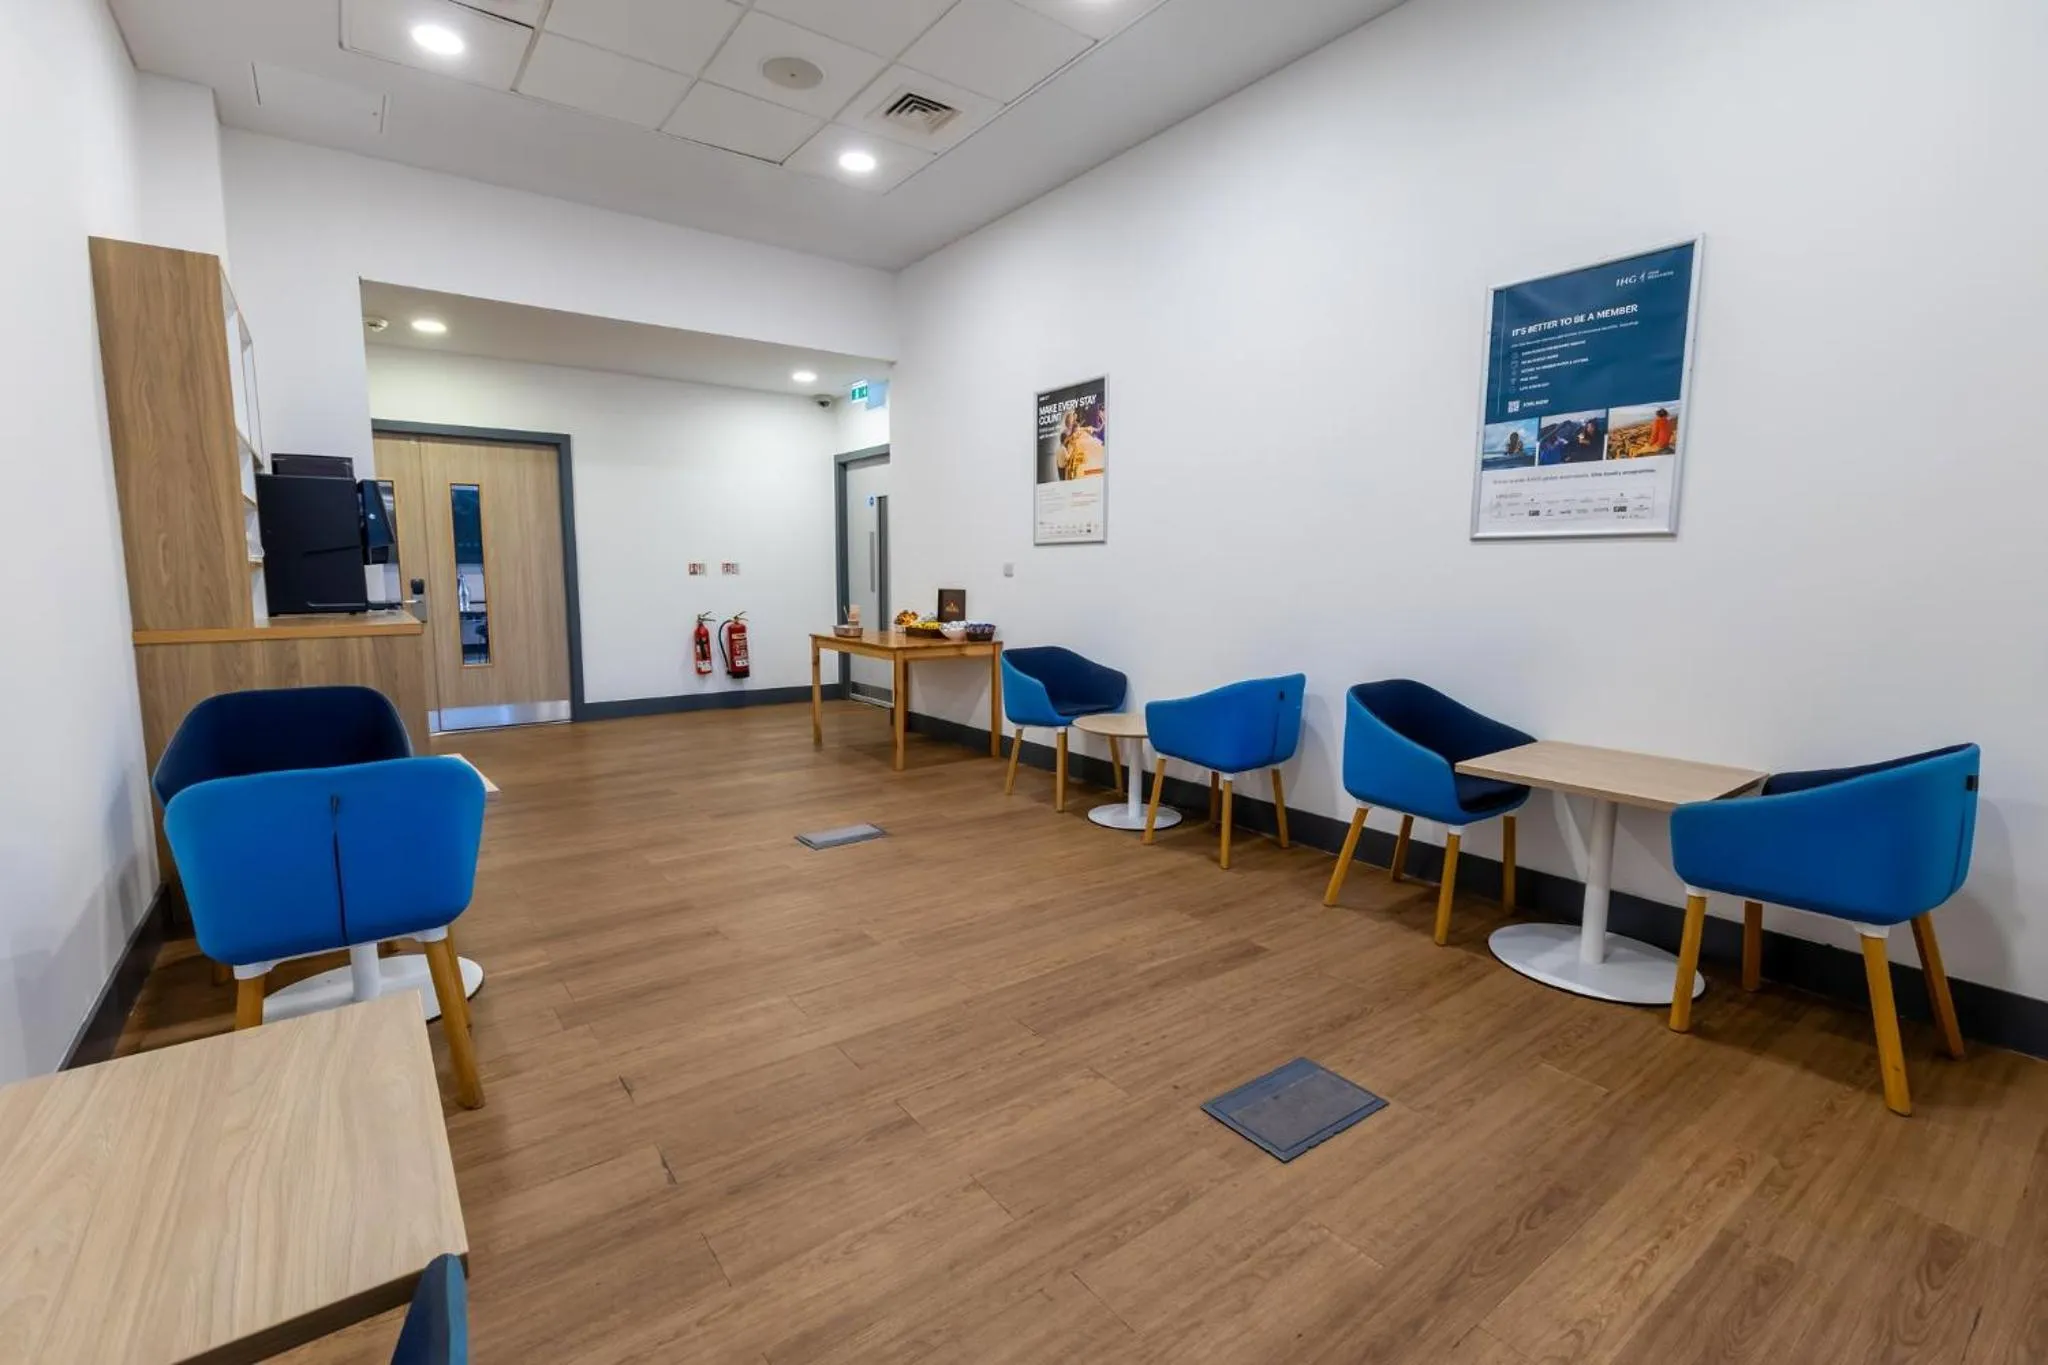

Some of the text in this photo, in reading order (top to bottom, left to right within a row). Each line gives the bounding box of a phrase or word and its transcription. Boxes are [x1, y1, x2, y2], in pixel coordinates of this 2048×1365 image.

[1616, 274, 1637, 287] IHG
[1527, 320, 1557, 334] BETTER
[1560, 317, 1572, 326] TO
[1573, 314, 1586, 323] BE
[1587, 312, 1595, 321] A
[1596, 303, 1638, 318] MEMBER
[1039, 403, 1058, 416] MAKE
[1058, 397, 1079, 413] EVERY
[1079, 393, 1097, 407] STAY
[1038, 413, 1062, 425] COUNT
